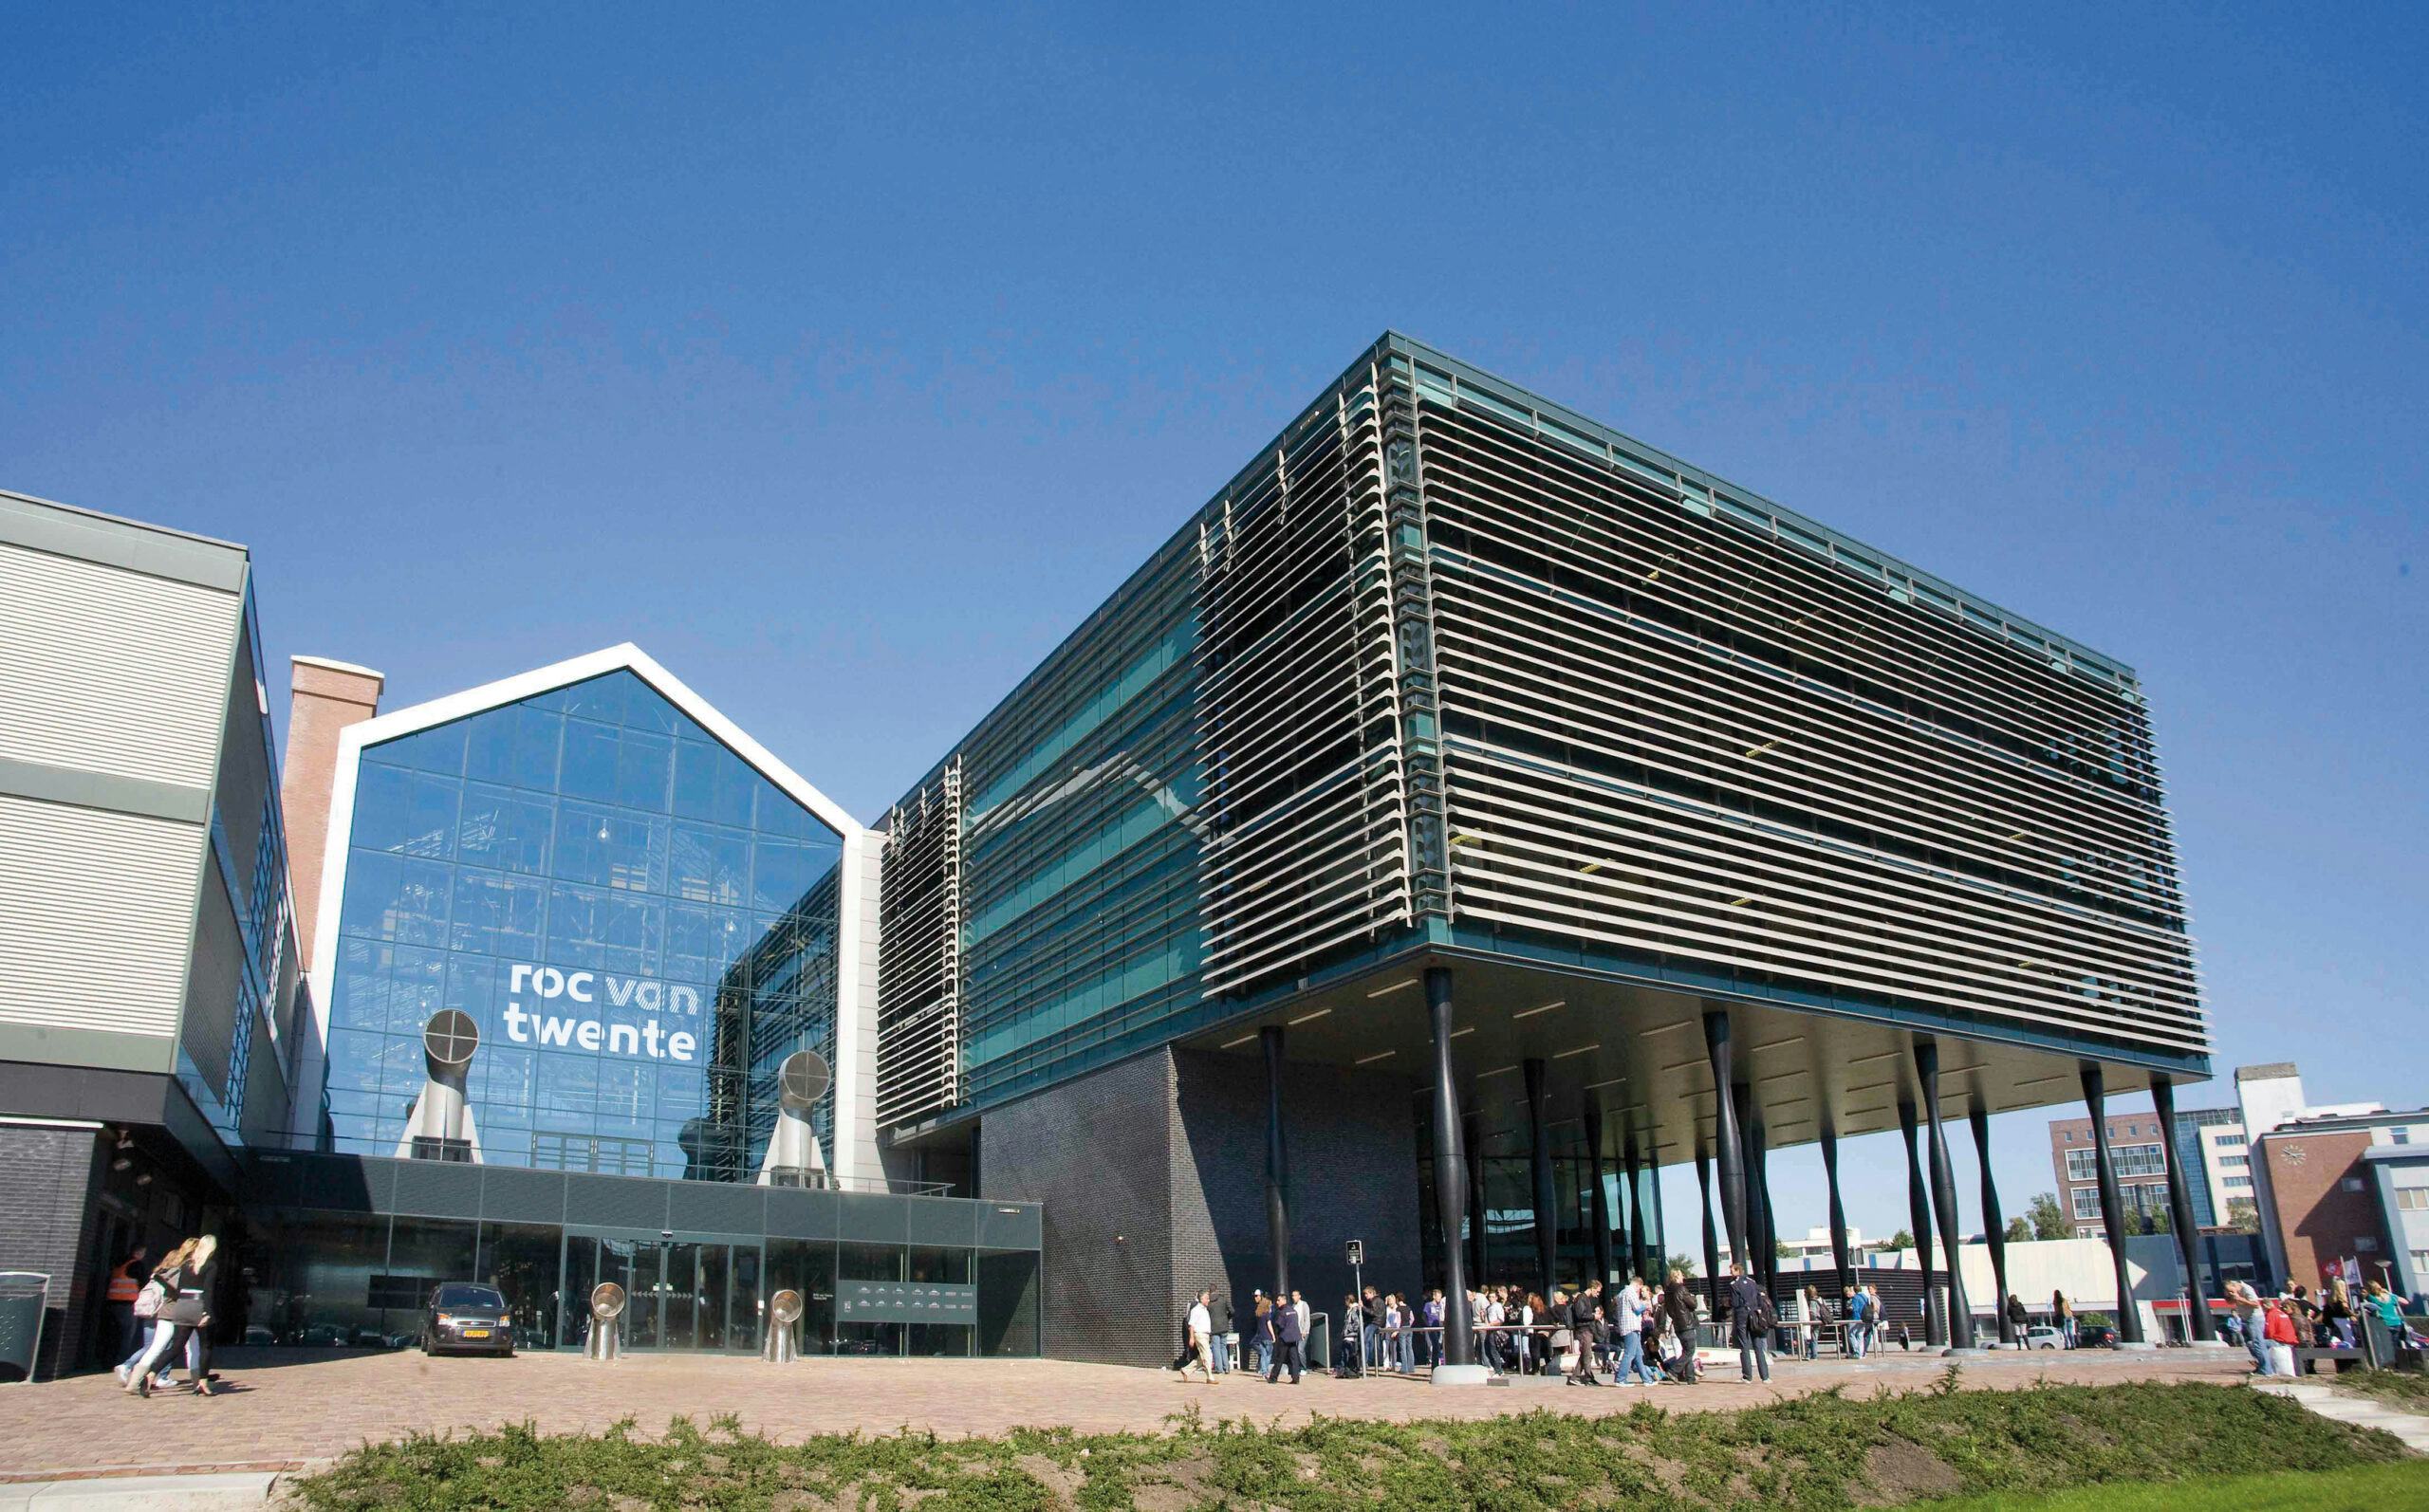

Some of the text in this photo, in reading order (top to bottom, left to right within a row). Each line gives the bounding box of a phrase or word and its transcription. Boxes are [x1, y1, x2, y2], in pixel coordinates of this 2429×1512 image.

[510, 964, 699, 1016] roc van
[503, 1002, 695, 1060] twente
